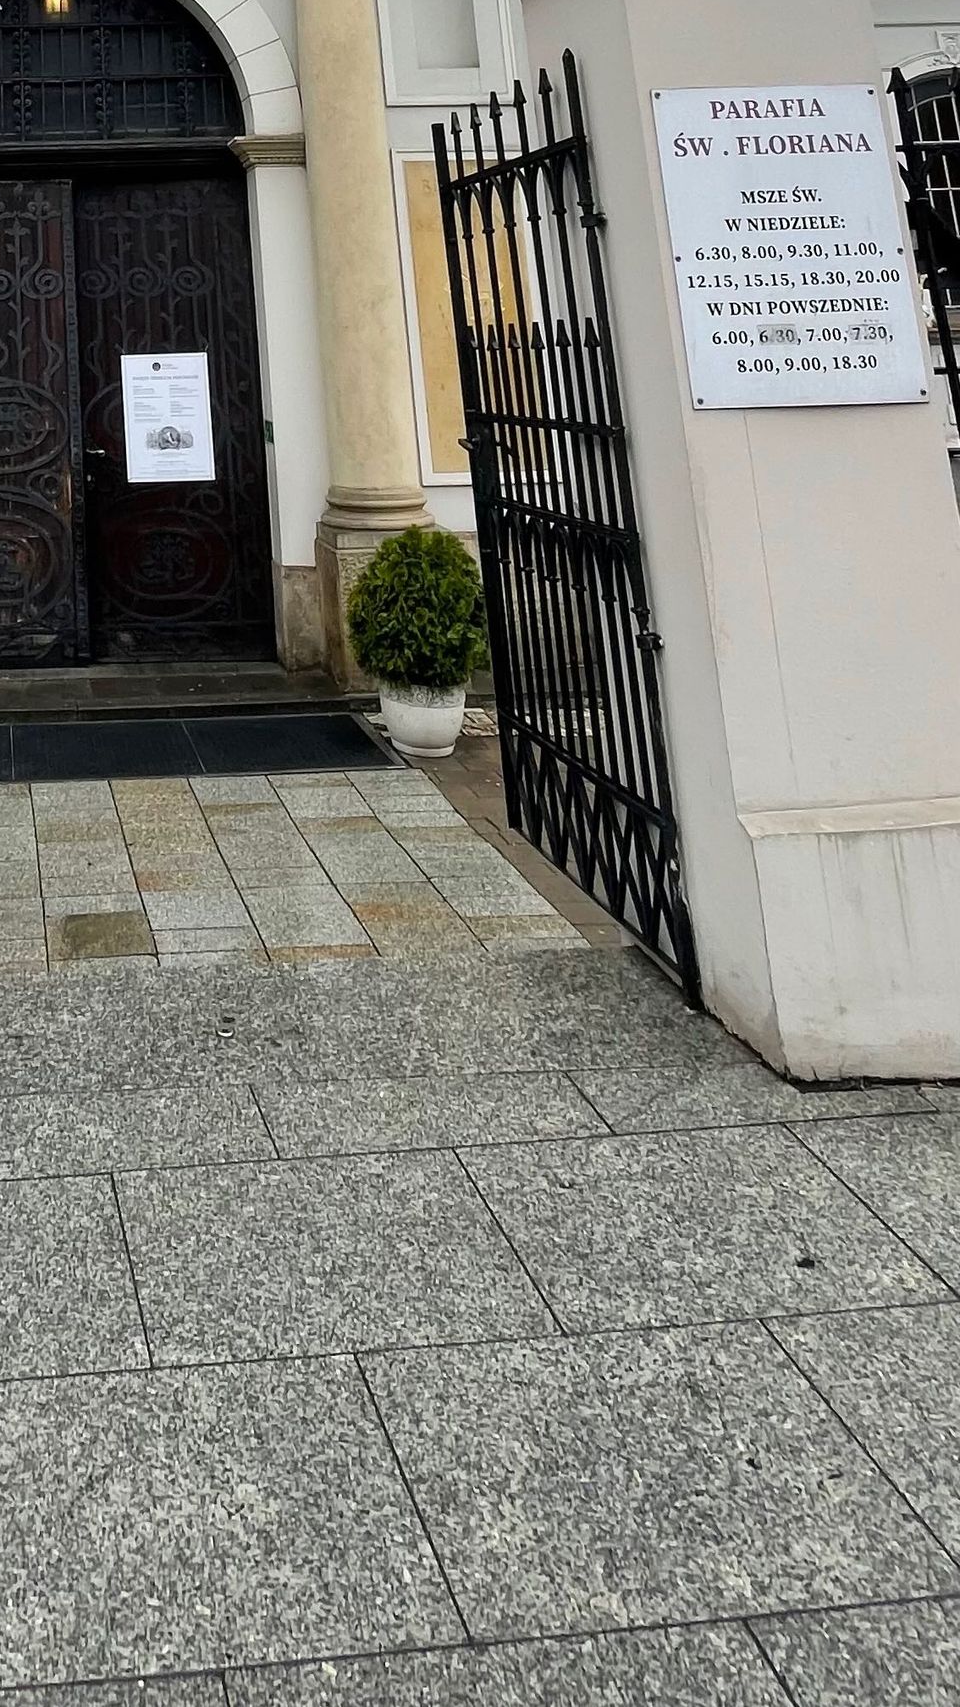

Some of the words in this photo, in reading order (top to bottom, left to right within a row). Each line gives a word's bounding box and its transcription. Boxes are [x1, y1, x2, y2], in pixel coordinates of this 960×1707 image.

[708, 97, 827, 120] PARAFIA
[735, 132, 873, 156] FLORIANA
[740, 189, 788, 204] MSZE
[792, 185, 822, 203] ŚW.
[725, 218, 743, 232] W
[746, 215, 846, 231] NIEDZIELE:
[694, 246, 737, 263] 6.30,
[741, 245, 784, 261] 8.00,
[787, 243, 829, 259] 9.30,
[833, 242, 884, 257] 11.00,
[687, 274, 739, 290] 12.15,
[743, 273, 795, 289] 15.15,
[800, 271, 851, 287] 18.30,
[855, 269, 900, 284] 20.00
[706, 302, 724, 316] W
[729, 301, 763, 316] DNI
[767, 298, 890, 315] POWSZEDNIE:
[711, 330, 754, 346] 6.00,
[805, 327, 848, 344] 7.00,
[851, 326, 894, 343] 7.30,
[736, 358, 780, 375] 8.00,
[784, 357, 827, 373] 9.00,
[832, 355, 878, 370] 18.30
